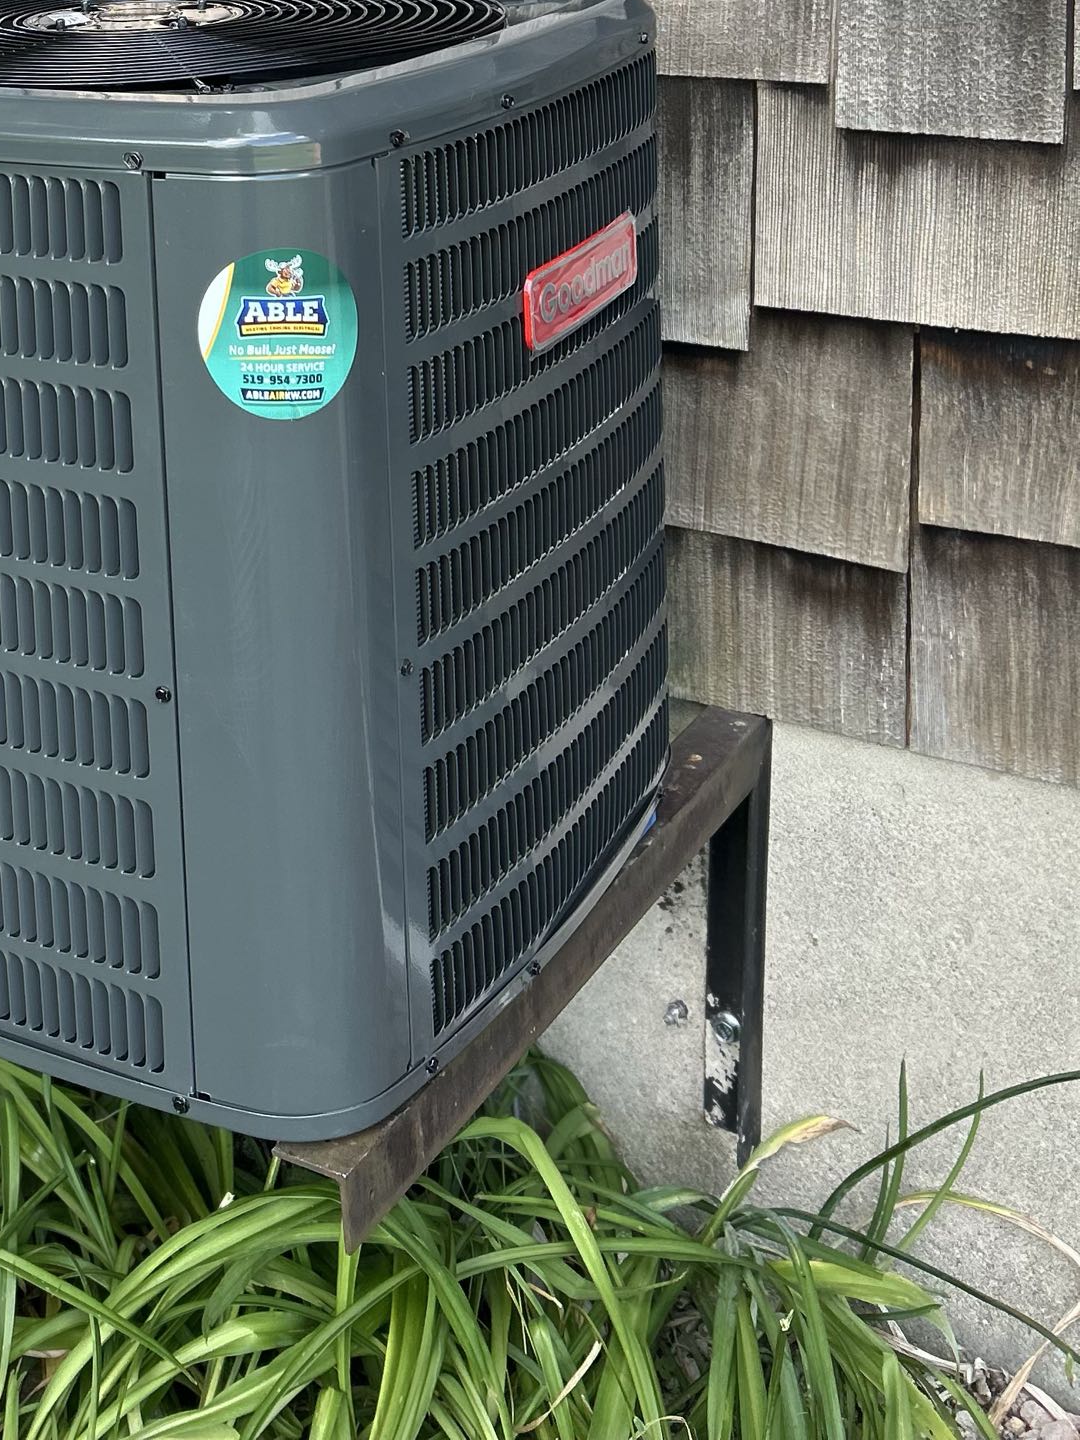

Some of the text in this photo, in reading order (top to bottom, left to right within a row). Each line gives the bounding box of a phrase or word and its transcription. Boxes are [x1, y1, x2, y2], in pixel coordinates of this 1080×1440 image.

[539, 240, 632, 324] Goodman
[244, 301, 319, 323] ABLE
[229, 344, 244, 355] No
[274, 344, 297, 355] Just
[299, 343, 336, 355] Moose!
[240, 361, 325, 373] 24 HOUR SERVICE
[242, 373, 323, 385] 519 954 7300
[245, 389, 321, 400] ABLEAIRKW.COM
